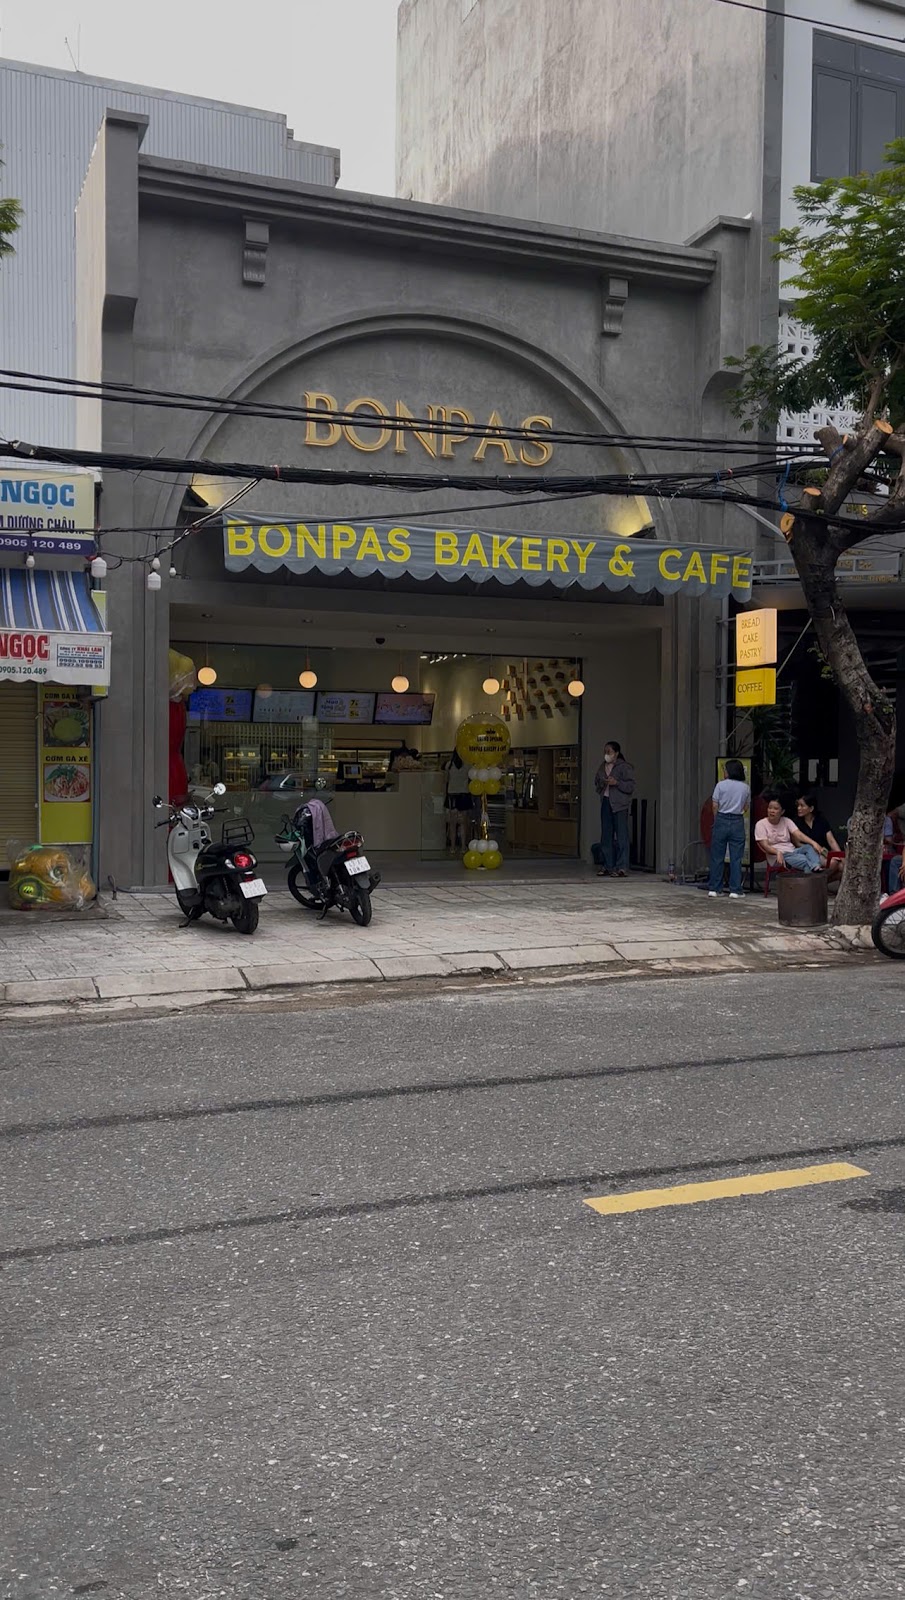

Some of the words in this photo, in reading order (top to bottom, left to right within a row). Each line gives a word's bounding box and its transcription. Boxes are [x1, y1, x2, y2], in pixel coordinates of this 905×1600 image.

[304, 391, 554, 467] BONPAS
[0, 480, 75, 509] NGỌC
[33, 541, 54, 549] 120
[58, 542, 81, 550] 489
[226, 519, 412, 563] BONPAS
[435, 531, 596, 574] BAKERY
[608, 544, 636, 578] &
[658, 549, 753, 589] CAFE
[741, 617, 760, 629] BREAD
[742, 633, 759, 644] CAKE
[0, 633, 49, 663] NGỌC
[739, 647, 762, 659] PASTRY
[737, 682, 763, 693] COFFEE
